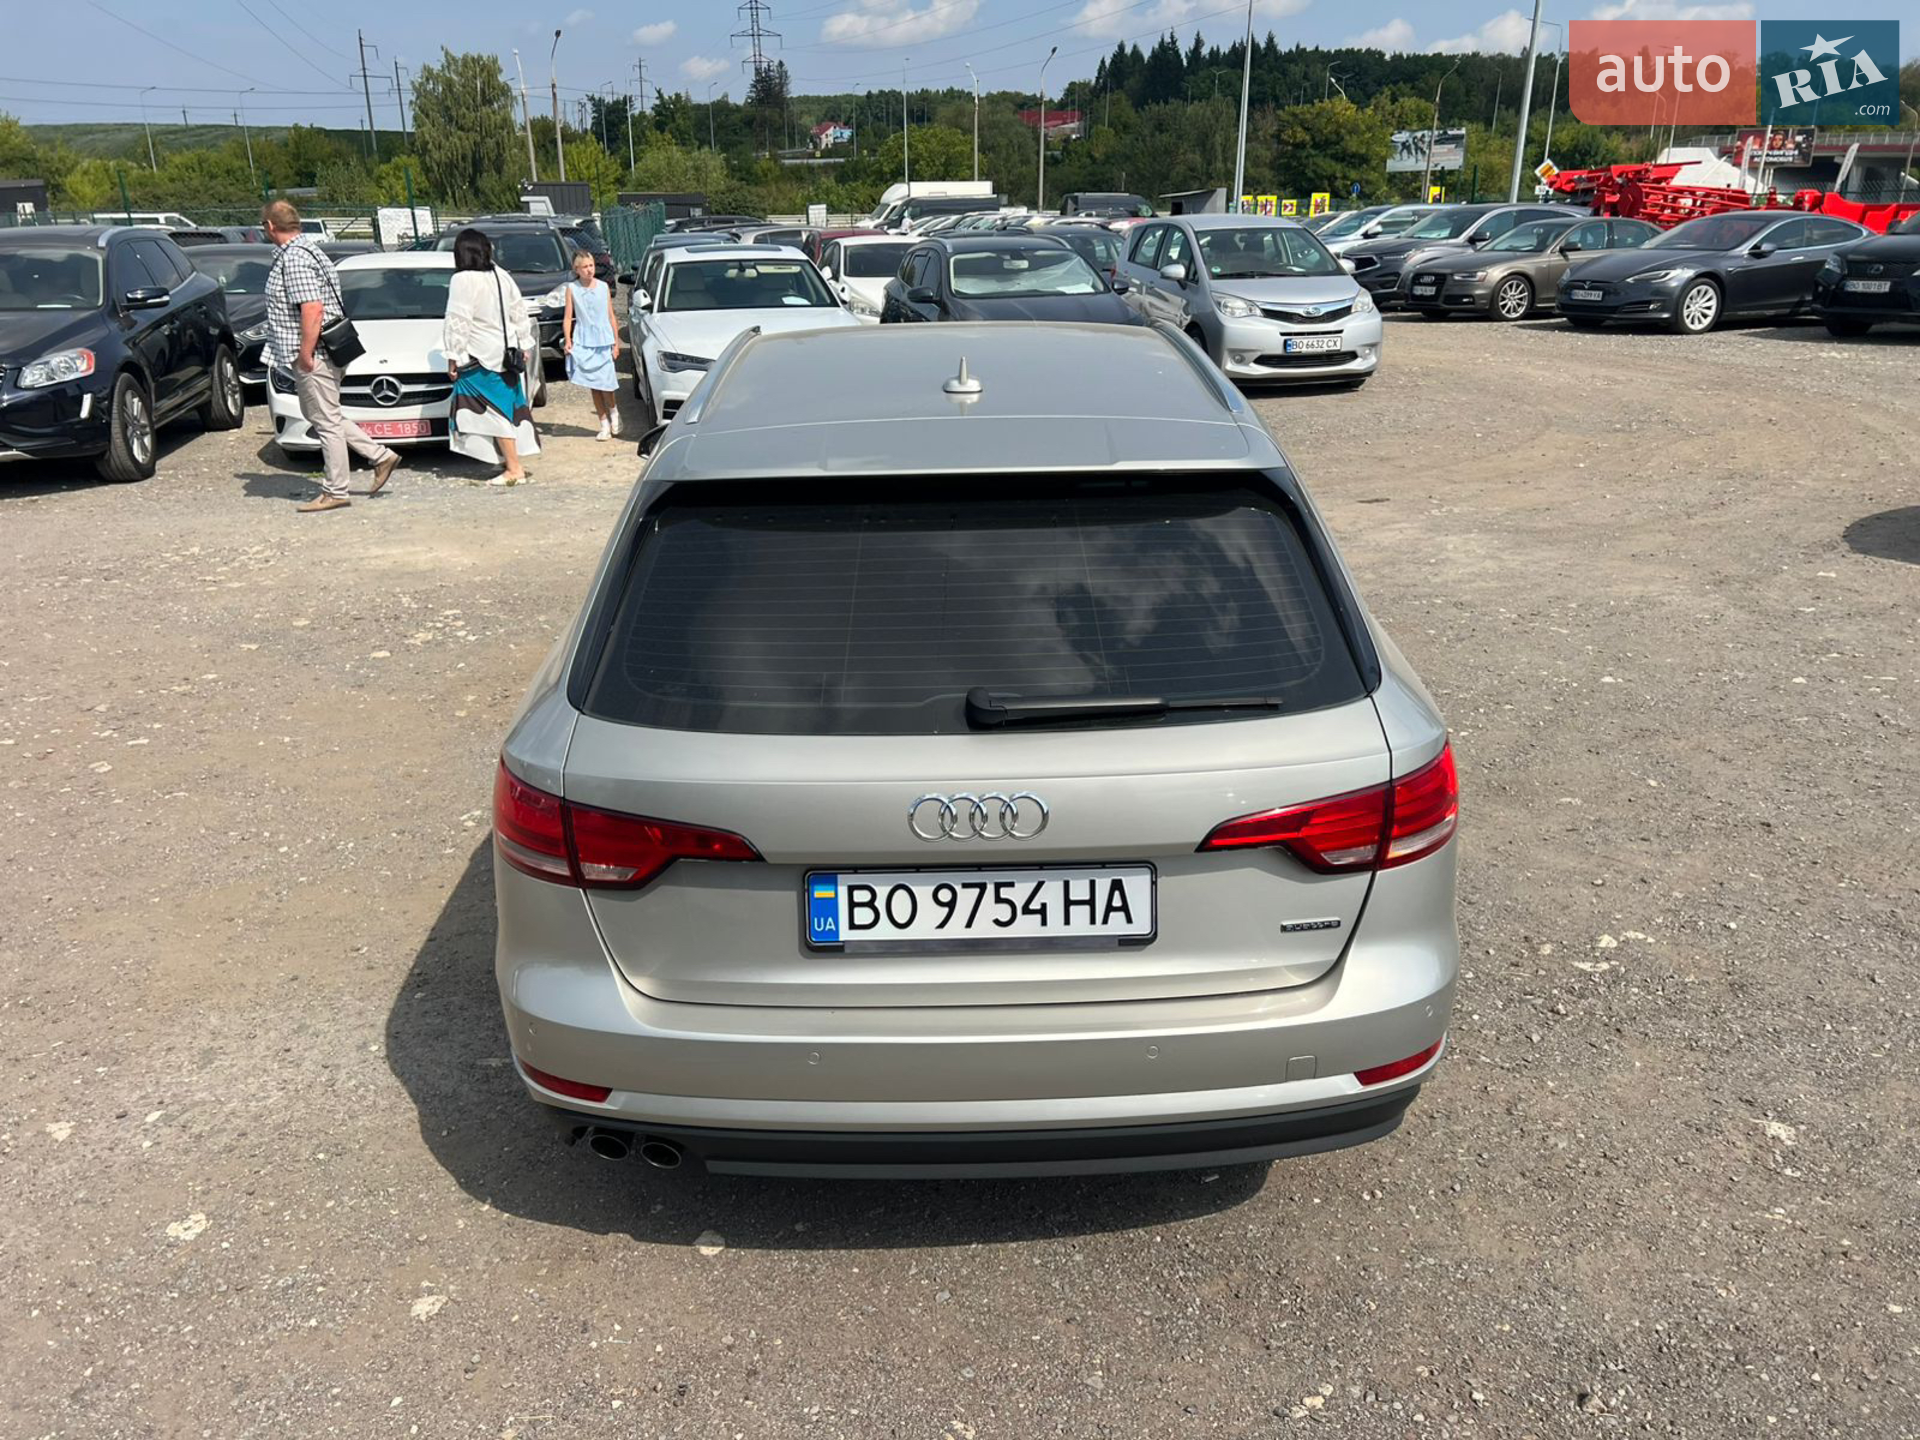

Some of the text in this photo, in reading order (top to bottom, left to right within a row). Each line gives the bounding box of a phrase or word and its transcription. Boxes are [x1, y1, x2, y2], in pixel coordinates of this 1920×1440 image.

[1291, 339, 1338, 350] BO 6632 CX
[374, 424, 393, 435] CE
[397, 422, 426, 434] 1850
[847, 878, 1134, 931] BO 9754 HA
[814, 916, 836, 932] UA
